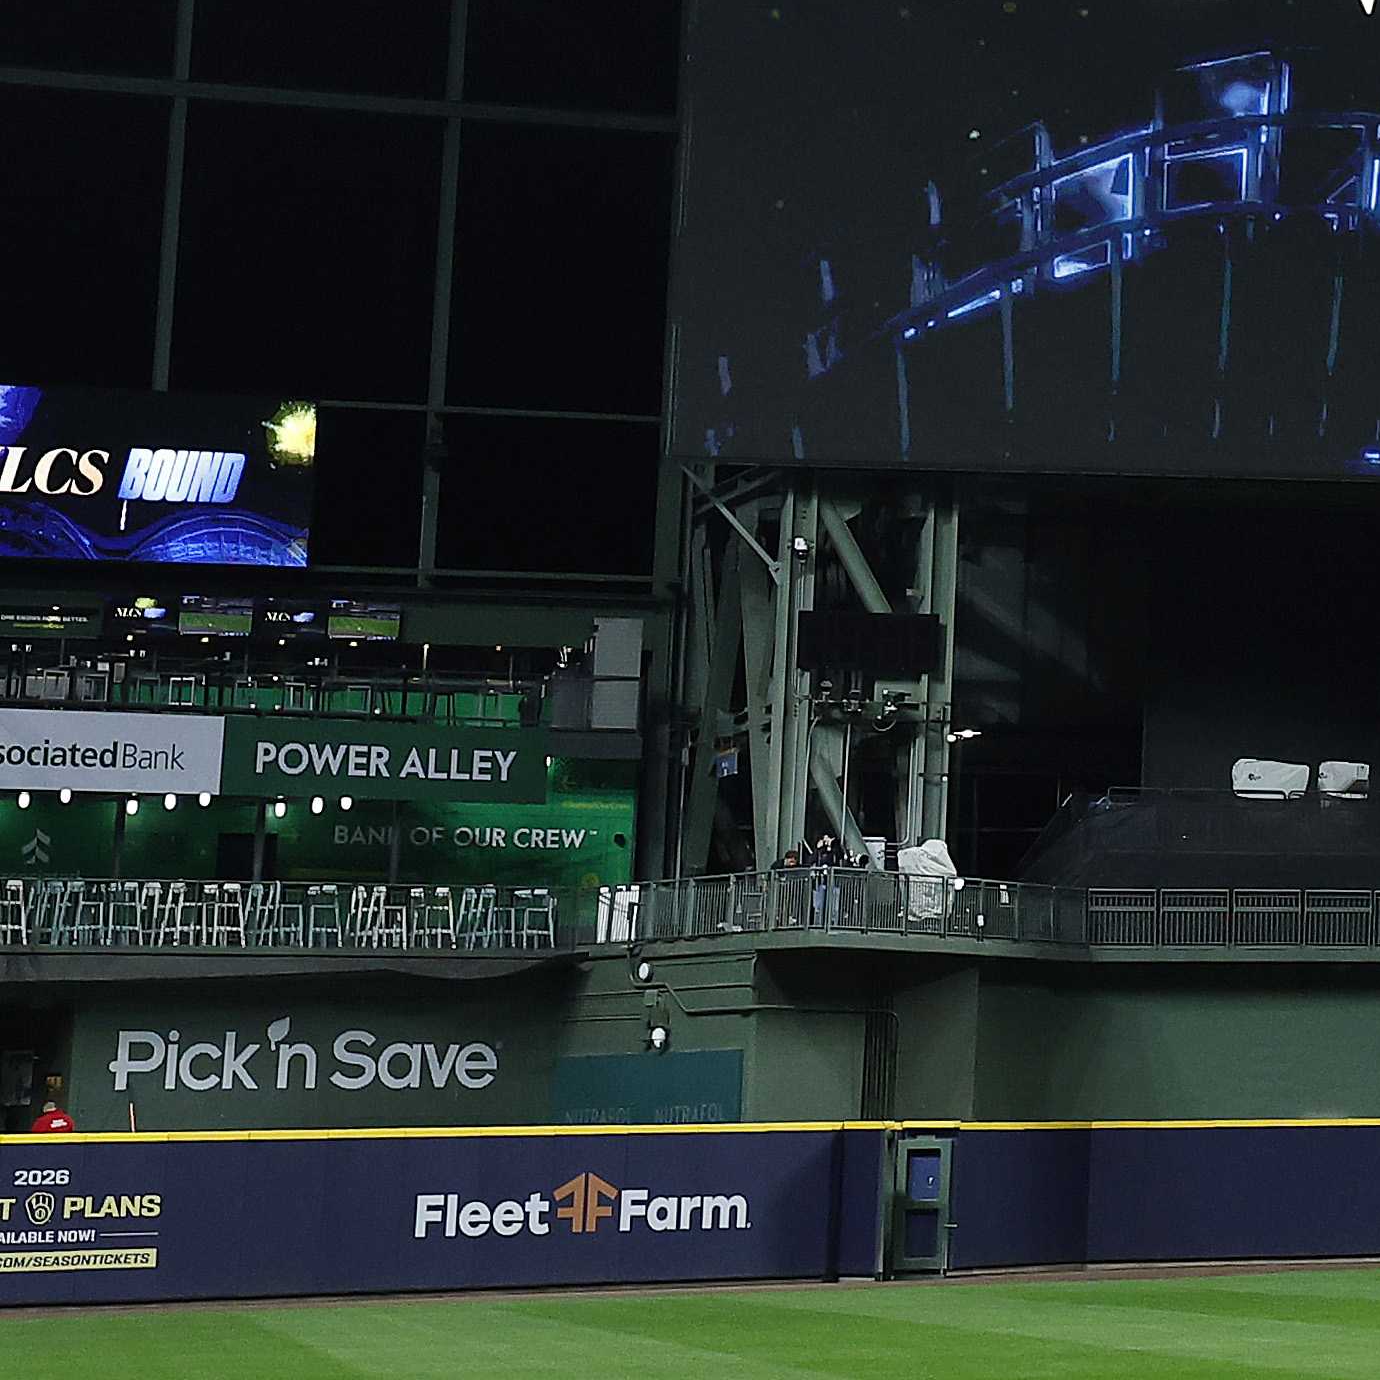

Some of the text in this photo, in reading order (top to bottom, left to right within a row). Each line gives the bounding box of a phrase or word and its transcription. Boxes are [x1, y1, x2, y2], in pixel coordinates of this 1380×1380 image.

[0, 446, 246, 503] LCS BOUND
[255, 741, 517, 782] POWER ALLEY
[410, 826, 446, 846] OF
[454, 826, 507, 848] OUR
[108, 1029, 261, 1091] Pick
[329, 1029, 499, 1090] Save
[14, 1170, 70, 1186] 2026
[63, 1195, 161, 1219] PLANS
[415, 1192, 549, 1238] Fleet
[57, 1229, 96, 1243] NOW!
